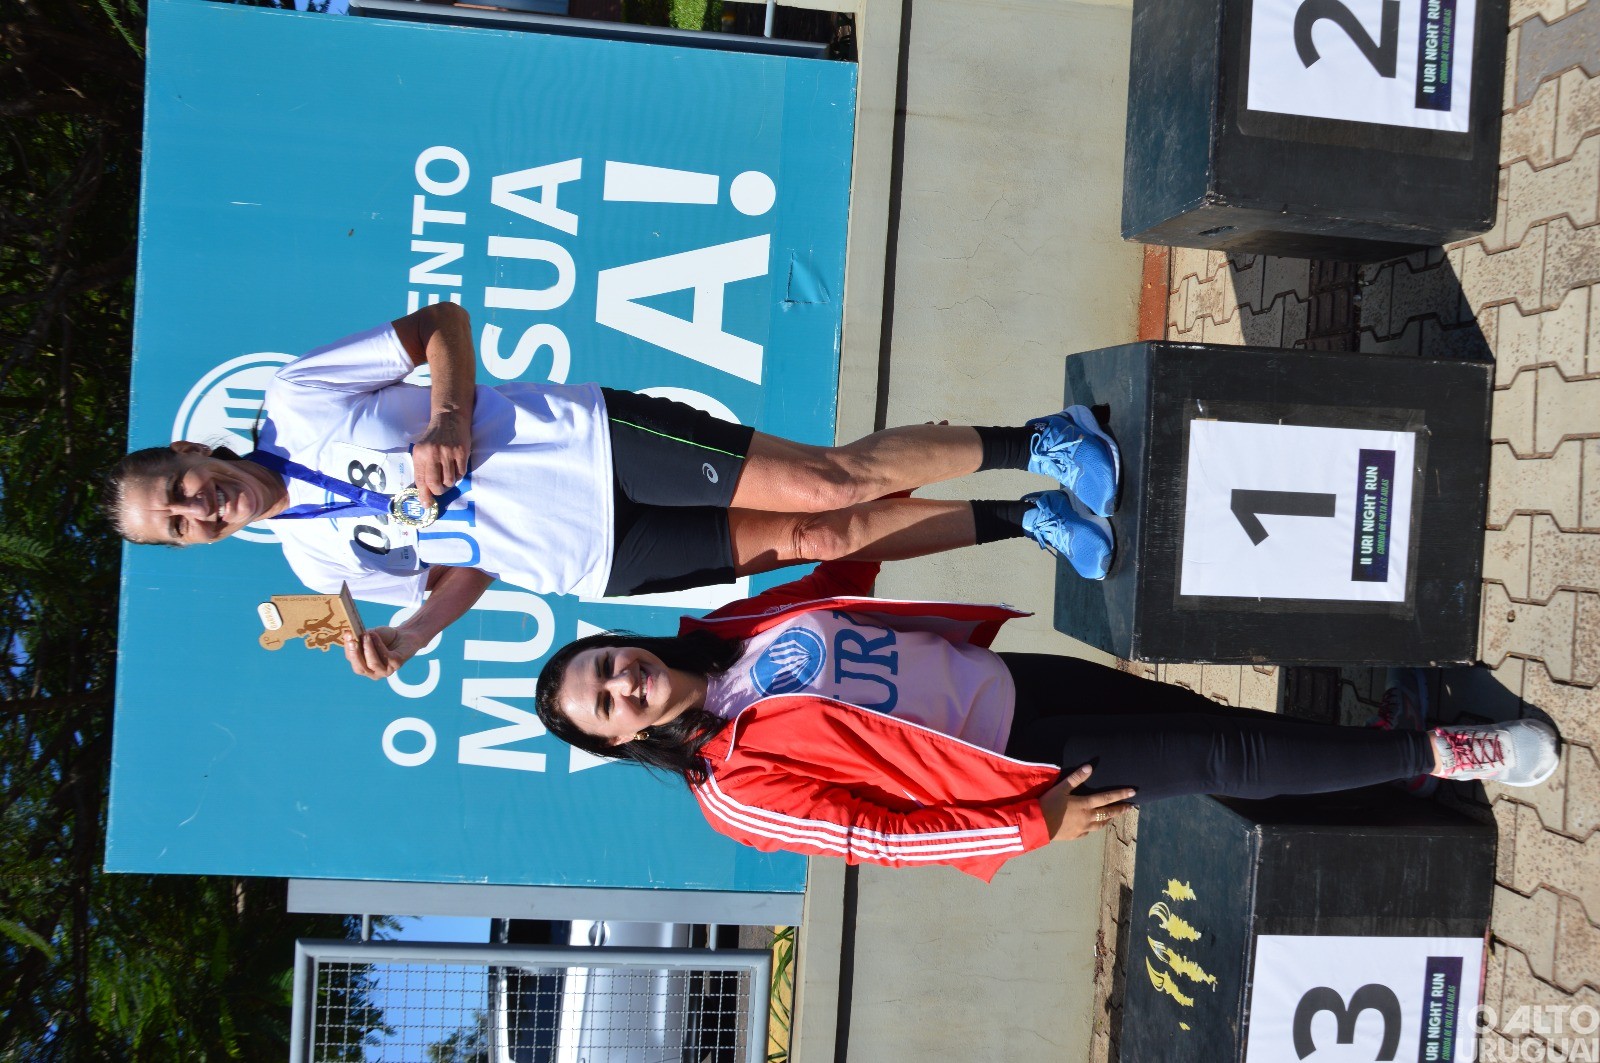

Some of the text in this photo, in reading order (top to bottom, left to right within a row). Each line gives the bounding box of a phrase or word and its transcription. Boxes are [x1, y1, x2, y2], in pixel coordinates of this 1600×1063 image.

[1293, 0, 1400, 78] 2
[1425, 22, 1438, 60] NIGHT
[1424, 64, 1436, 82] URI
[480, 158, 582, 384] SUA
[1365, 466, 1378, 490] RUN
[1380, 478, 1389, 497] AULAS
[347, 460, 391, 555] 08
[1230, 488, 1336, 546] 1
[1362, 494, 1377, 532] NIGHT
[1378, 506, 1388, 522] VOLTA
[1378, 522, 1386, 530] DE
[1361, 535, 1374, 554] URI
[1377, 531, 1386, 554] CORRIDA
[382, 717, 436, 767] O
[1446, 984, 1456, 1003] AULAS
[1293, 983, 1402, 1063] 3
[1426, 972, 1445, 1060] URI NIGHT RUN
[1444, 1012, 1453, 1028] VOLTA
